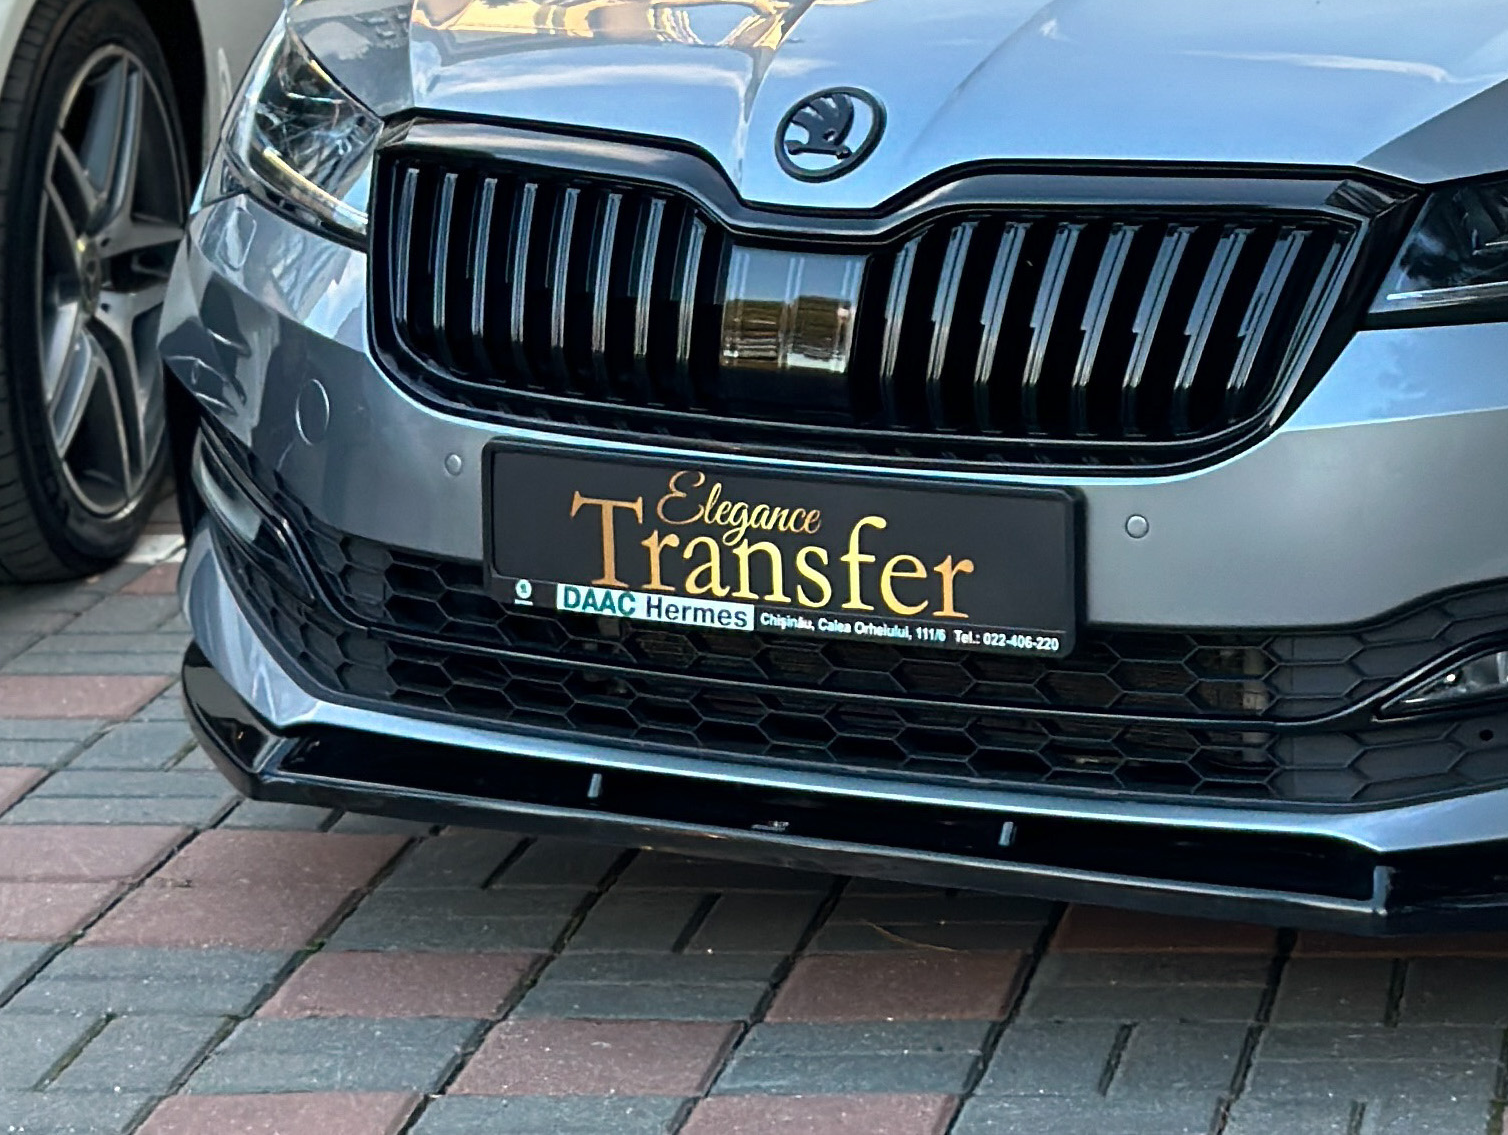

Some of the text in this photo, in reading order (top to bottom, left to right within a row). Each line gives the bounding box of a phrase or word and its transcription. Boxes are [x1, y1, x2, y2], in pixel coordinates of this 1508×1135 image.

[656, 470, 822, 546] Elegance
[569, 489, 975, 619] Transfer
[563, 585, 749, 629] DAAC Hermes
[818, 617, 852, 634] Calea
[915, 626, 947, 642] 111/6
[953, 629, 981, 645] Tel.:
[982, 632, 1060, 652] 022-406-220
